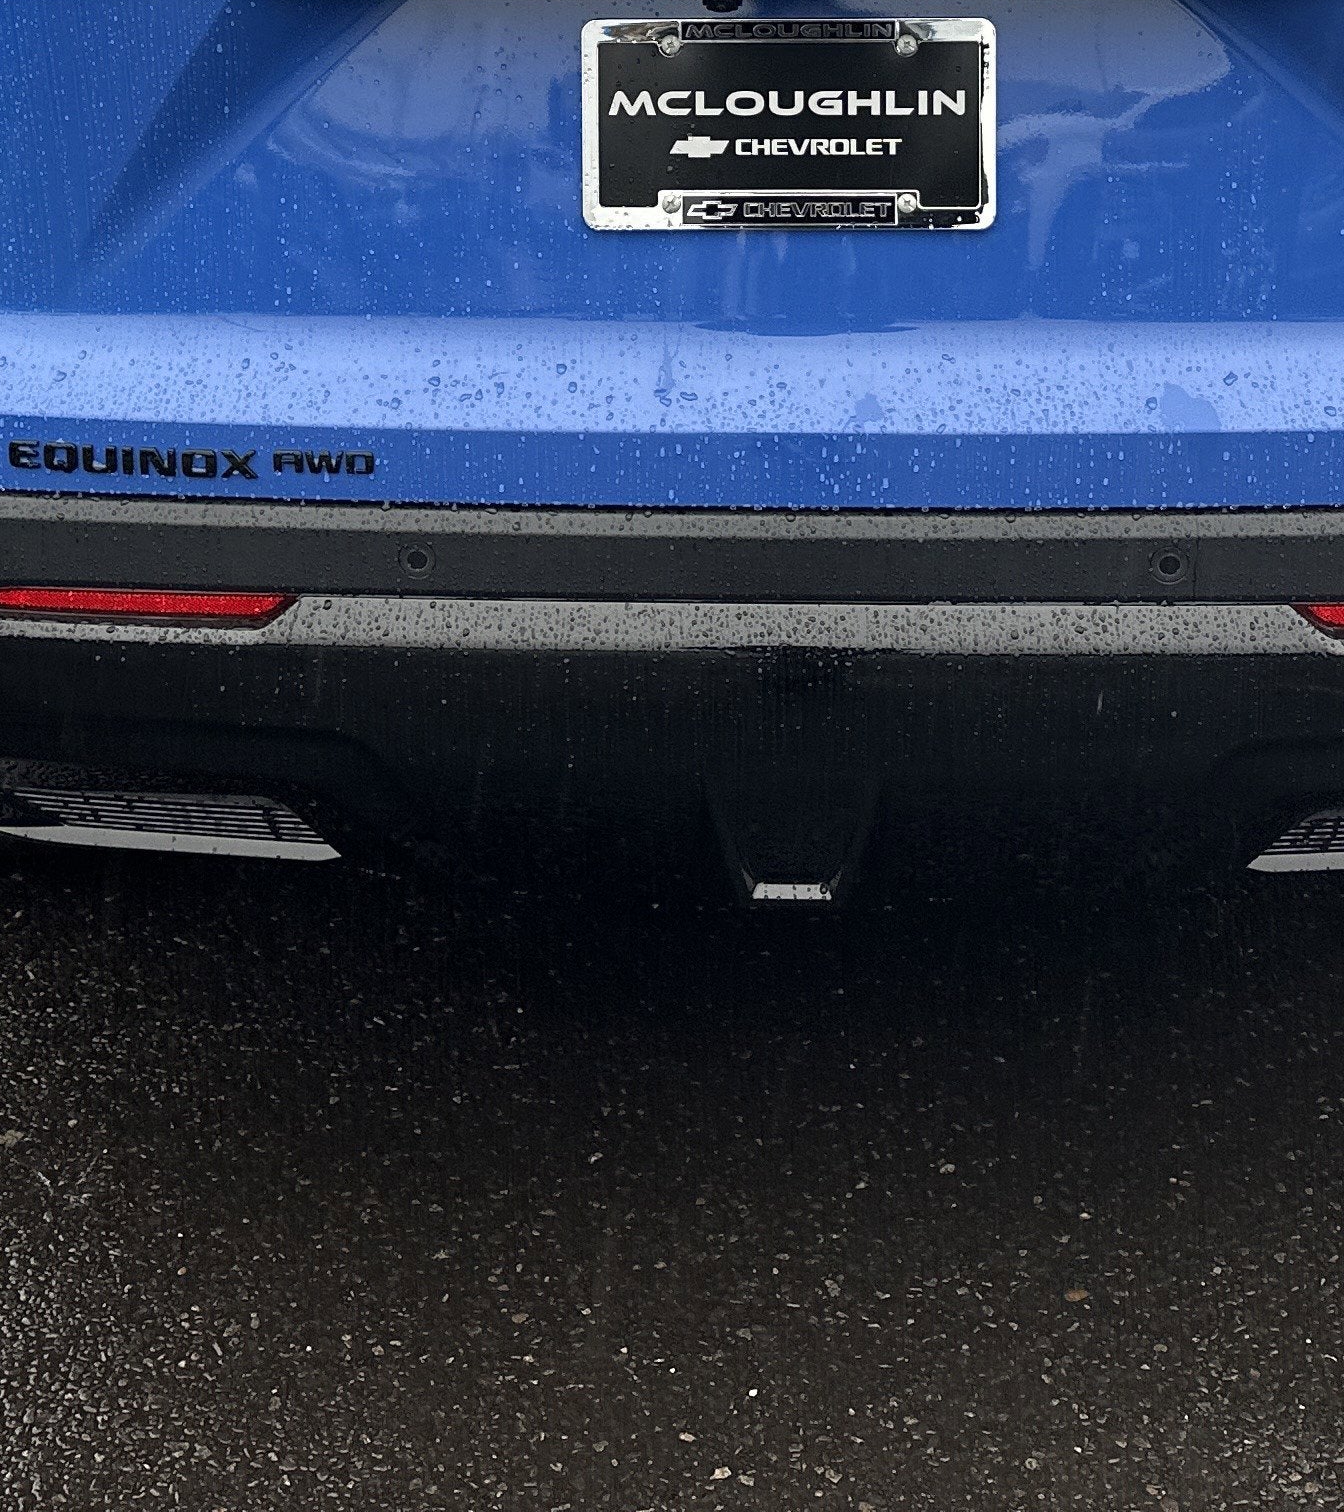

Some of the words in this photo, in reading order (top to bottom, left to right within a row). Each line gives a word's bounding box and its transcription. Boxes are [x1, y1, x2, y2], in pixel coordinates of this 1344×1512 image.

[685, 23, 893, 39] MCLOUGHLIN
[608, 89, 967, 117] MCLOUGHLIN
[735, 138, 903, 156] CHEVROLET
[743, 201, 892, 218] CHEVROLET
[8, 439, 258, 479] EQUINOX
[272, 449, 375, 475] AWD
